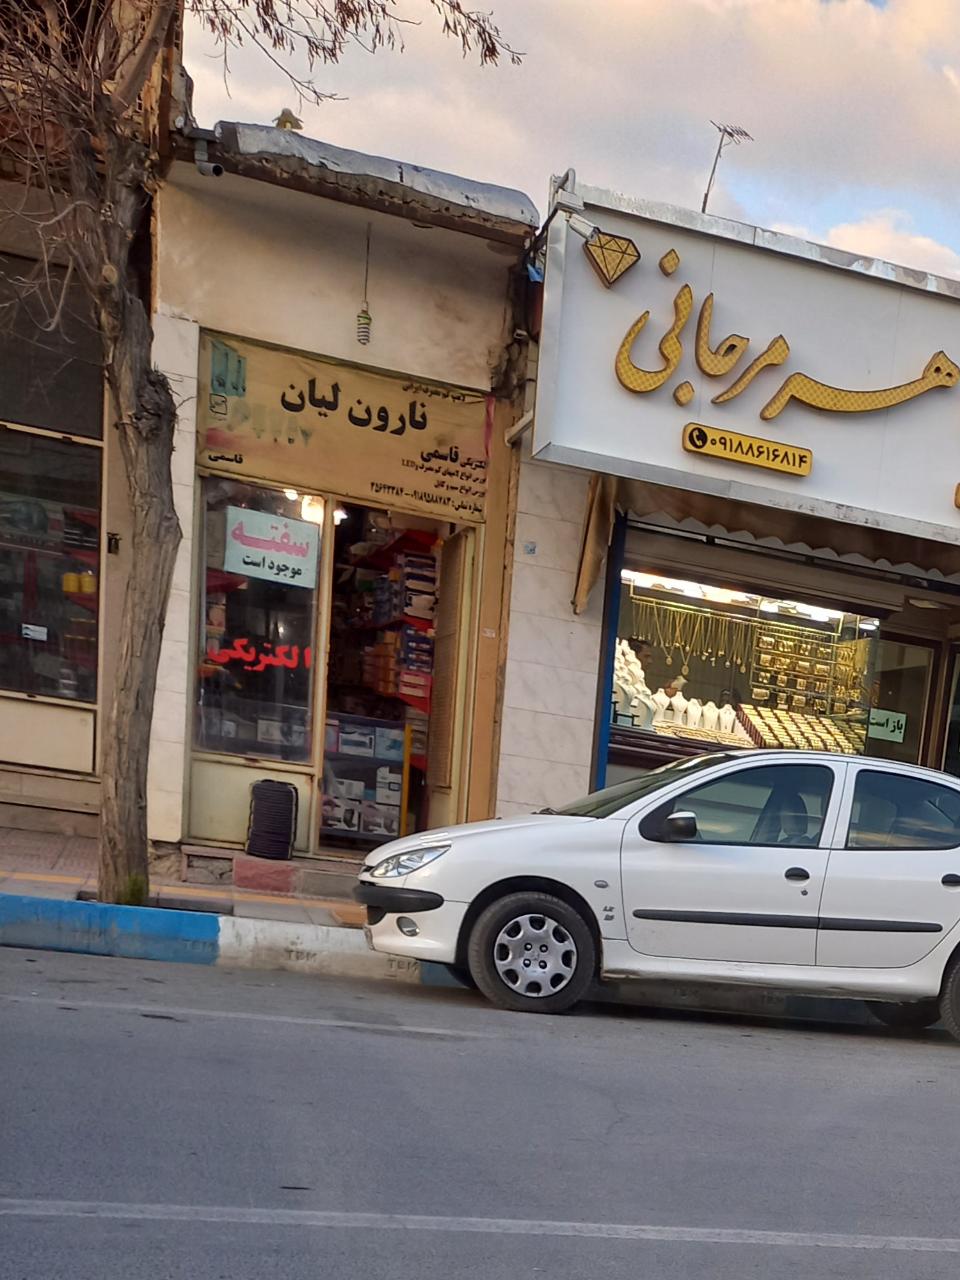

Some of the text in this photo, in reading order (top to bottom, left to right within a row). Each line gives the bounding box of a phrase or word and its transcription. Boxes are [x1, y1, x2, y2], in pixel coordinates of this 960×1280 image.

[613, 247, 791, 407] مرجانی
[280, 377, 427, 436] نارون لیان
[208, 452, 243, 464] قاسمی
[709, 436, 809, 468] ۰۹۱۸۸۶۱۶۸۱۴
[231, 520, 309, 558] سفته
[242, 554, 302, 578] موجود است
[207, 637, 311, 672] الکتریکی
[869, 717, 904, 733] باز است
